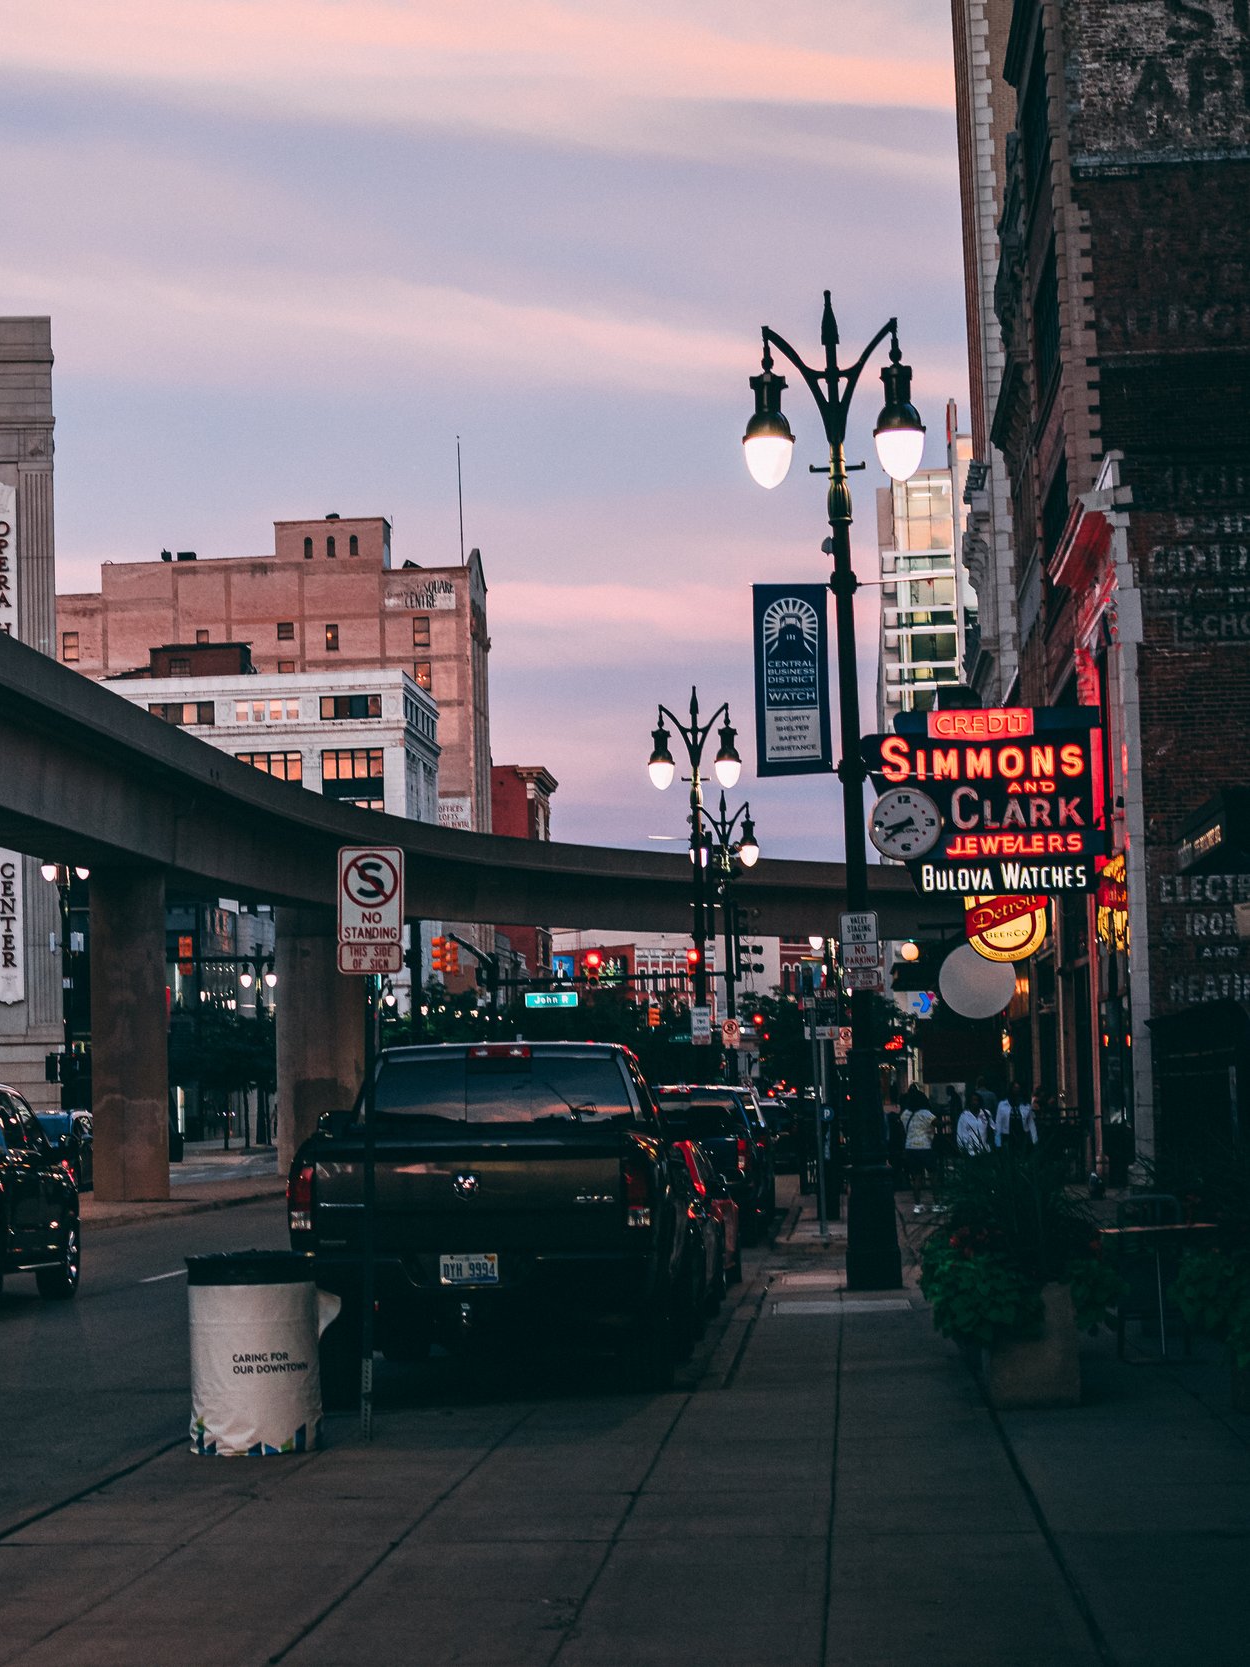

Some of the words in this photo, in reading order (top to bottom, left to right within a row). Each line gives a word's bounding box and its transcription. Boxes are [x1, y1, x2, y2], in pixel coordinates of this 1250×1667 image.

[404, 594, 438, 608] CENTRE
[767, 660, 814, 668] CENTRAL
[767, 668, 815, 676] BUSINESS
[767, 676, 815, 684] DISTRICT
[768, 692, 816, 702] WATCH
[775, 724, 810, 732] SHELTER
[936, 714, 1027, 735] CREDIT
[778, 734, 807, 742] SAFETY
[770, 744, 817, 752] ASSISTANCE
[880, 736, 1084, 783] SIMMONS
[1006, 780, 1056, 795] AND
[951, 786, 1086, 830] CLARK
[946, 833, 1084, 857] JEWELERS
[922, 864, 994, 892] BULOVA
[1001, 862, 1086, 890] WATCHES
[0, 862, 17, 968] CENTER
[361, 911, 382, 924] NO
[344, 926, 397, 939] STANDING
[846, 925, 871, 934] STAGING
[851, 933, 867, 941] ONLY
[350, 946, 367, 957] THIS
[374, 946, 392, 957] SIDE
[854, 945, 867, 955] NO
[352, 958, 362, 969] OF
[370, 958, 389, 969] SIGN
[845, 956, 876, 965] PARKING
[534, 996, 558, 1004] John
[469, 1261, 496, 1277] 9994
[232, 1353, 268, 1363] CARING
[270, 1352, 289, 1361] FOR
[233, 1365, 254, 1374] OUR
[256, 1362, 308, 1374] DOWNTOWN
